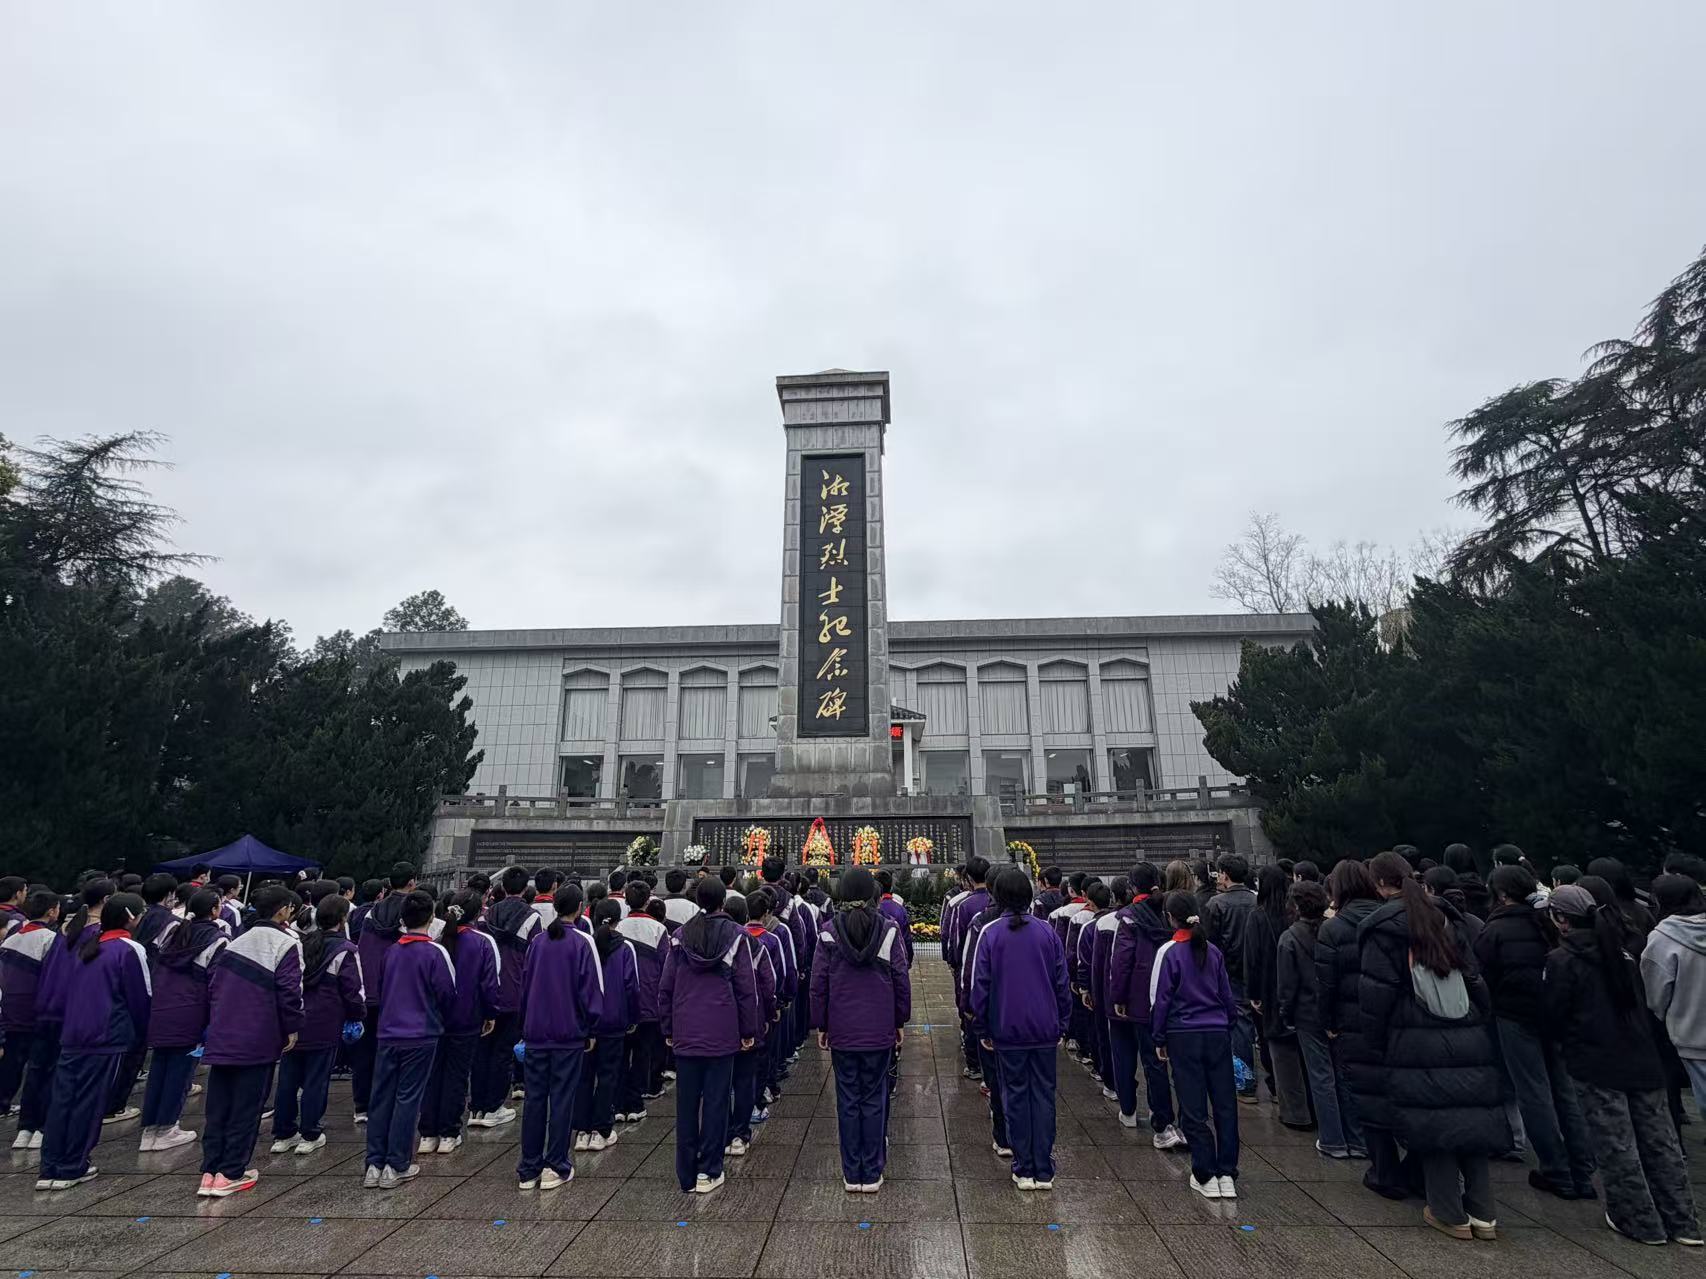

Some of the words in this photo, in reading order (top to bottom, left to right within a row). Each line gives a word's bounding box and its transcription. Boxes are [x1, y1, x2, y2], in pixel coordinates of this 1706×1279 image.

[817, 469, 851, 720] 湘潭烈士纪念碑
